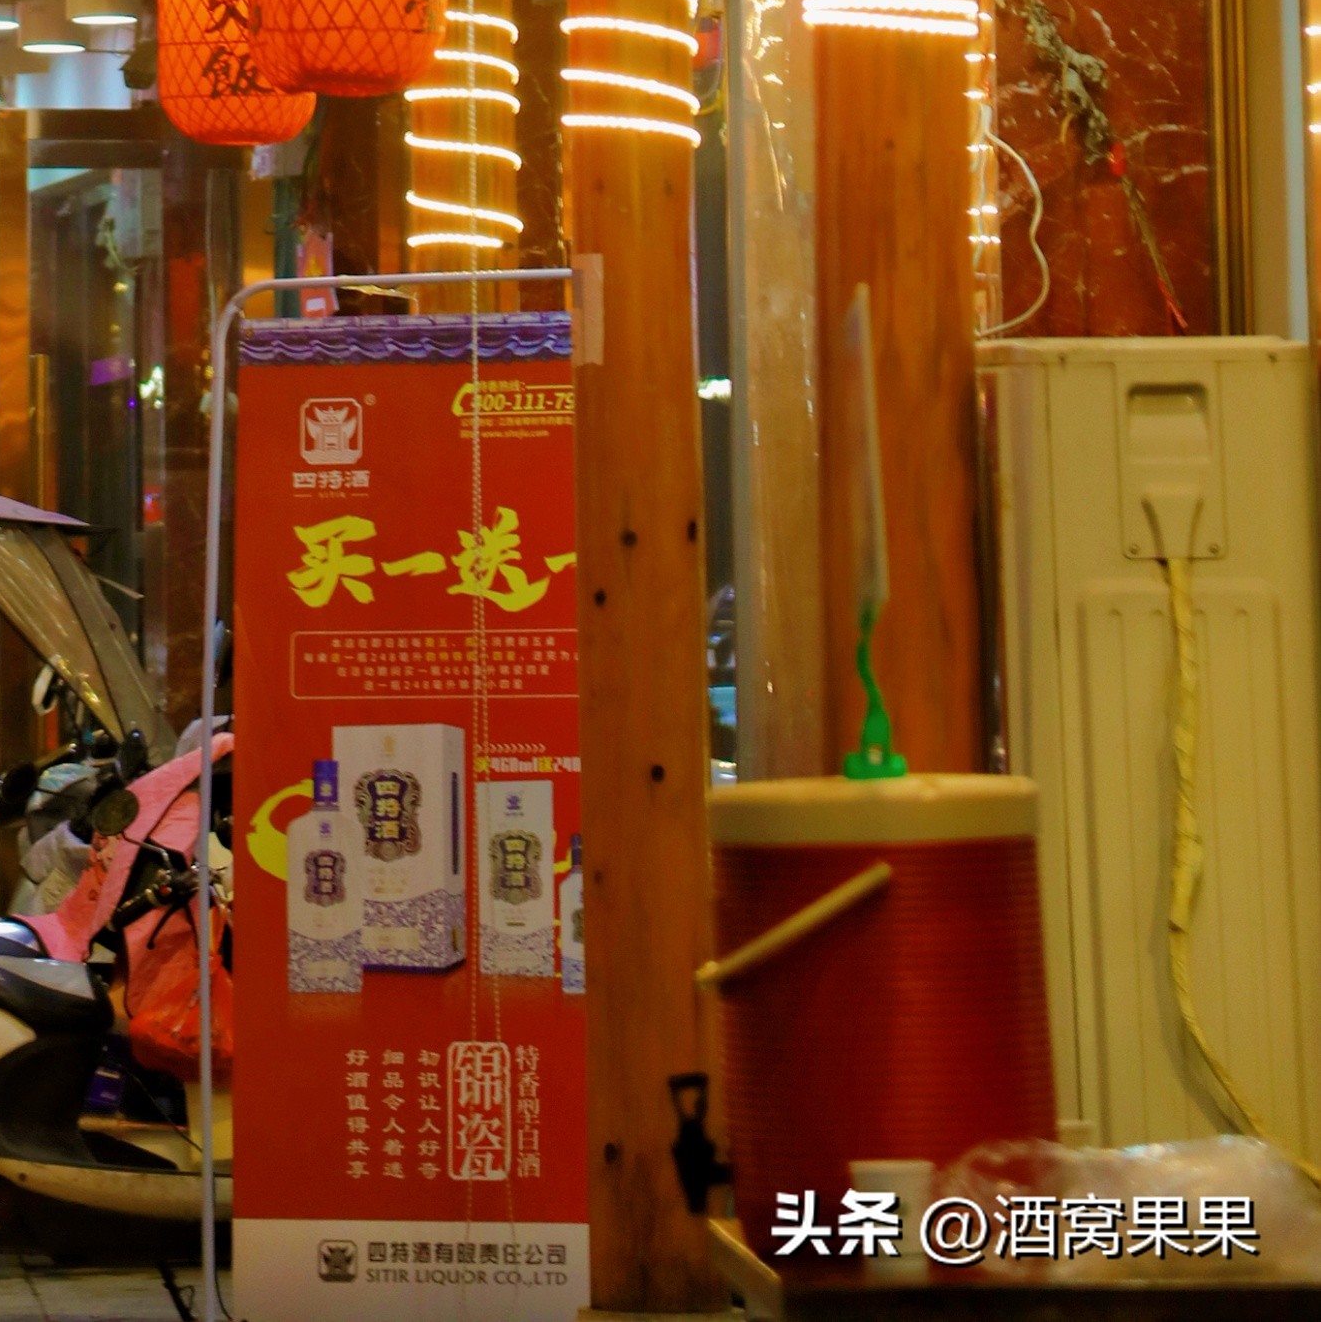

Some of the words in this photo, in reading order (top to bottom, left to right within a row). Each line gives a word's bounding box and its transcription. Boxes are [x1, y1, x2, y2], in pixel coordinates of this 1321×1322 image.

[292, 469, 370, 489] 四特酒
[515, 1044, 540, 1178] 特香型白酒
[367, 1242, 567, 1264] 四特酒有限责任公司
[366, 1269, 409, 1283] SITIR
[415, 1270, 487, 1285] LIQUOR
